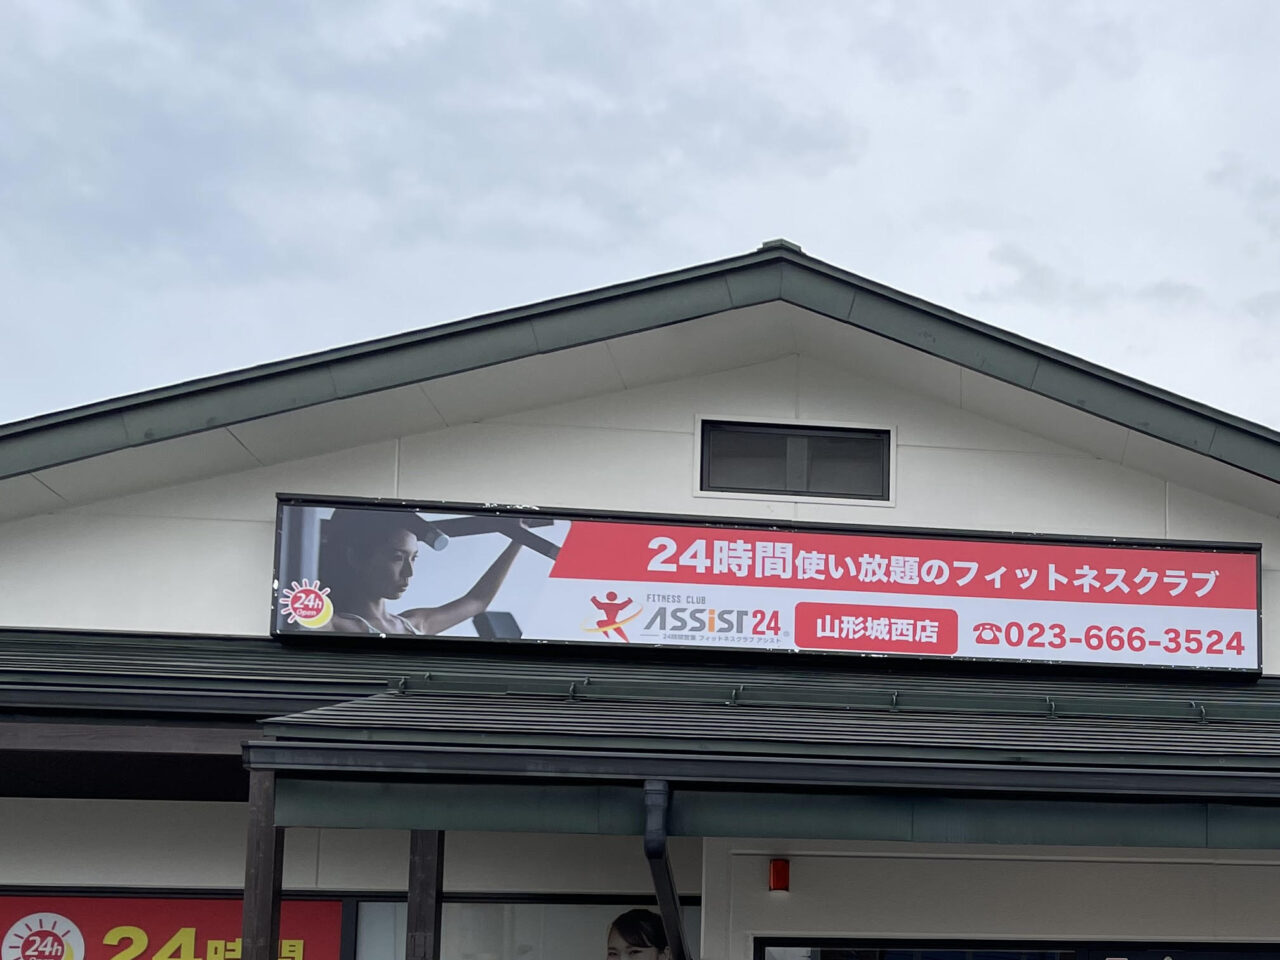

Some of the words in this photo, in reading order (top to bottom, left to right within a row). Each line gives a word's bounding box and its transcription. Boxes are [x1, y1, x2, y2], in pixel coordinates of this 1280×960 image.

[646, 536, 1219, 597] 24時間使い放題のフィットネスクラブ
[293, 593, 322, 608] 24h
[646, 593, 681, 604] FITNESS
[686, 595, 706, 605] CLUB
[816, 614, 939, 644] 山形城西店
[1004, 622, 1245, 656] 023-666-3524
[25, 936, 62, 956] 24h
